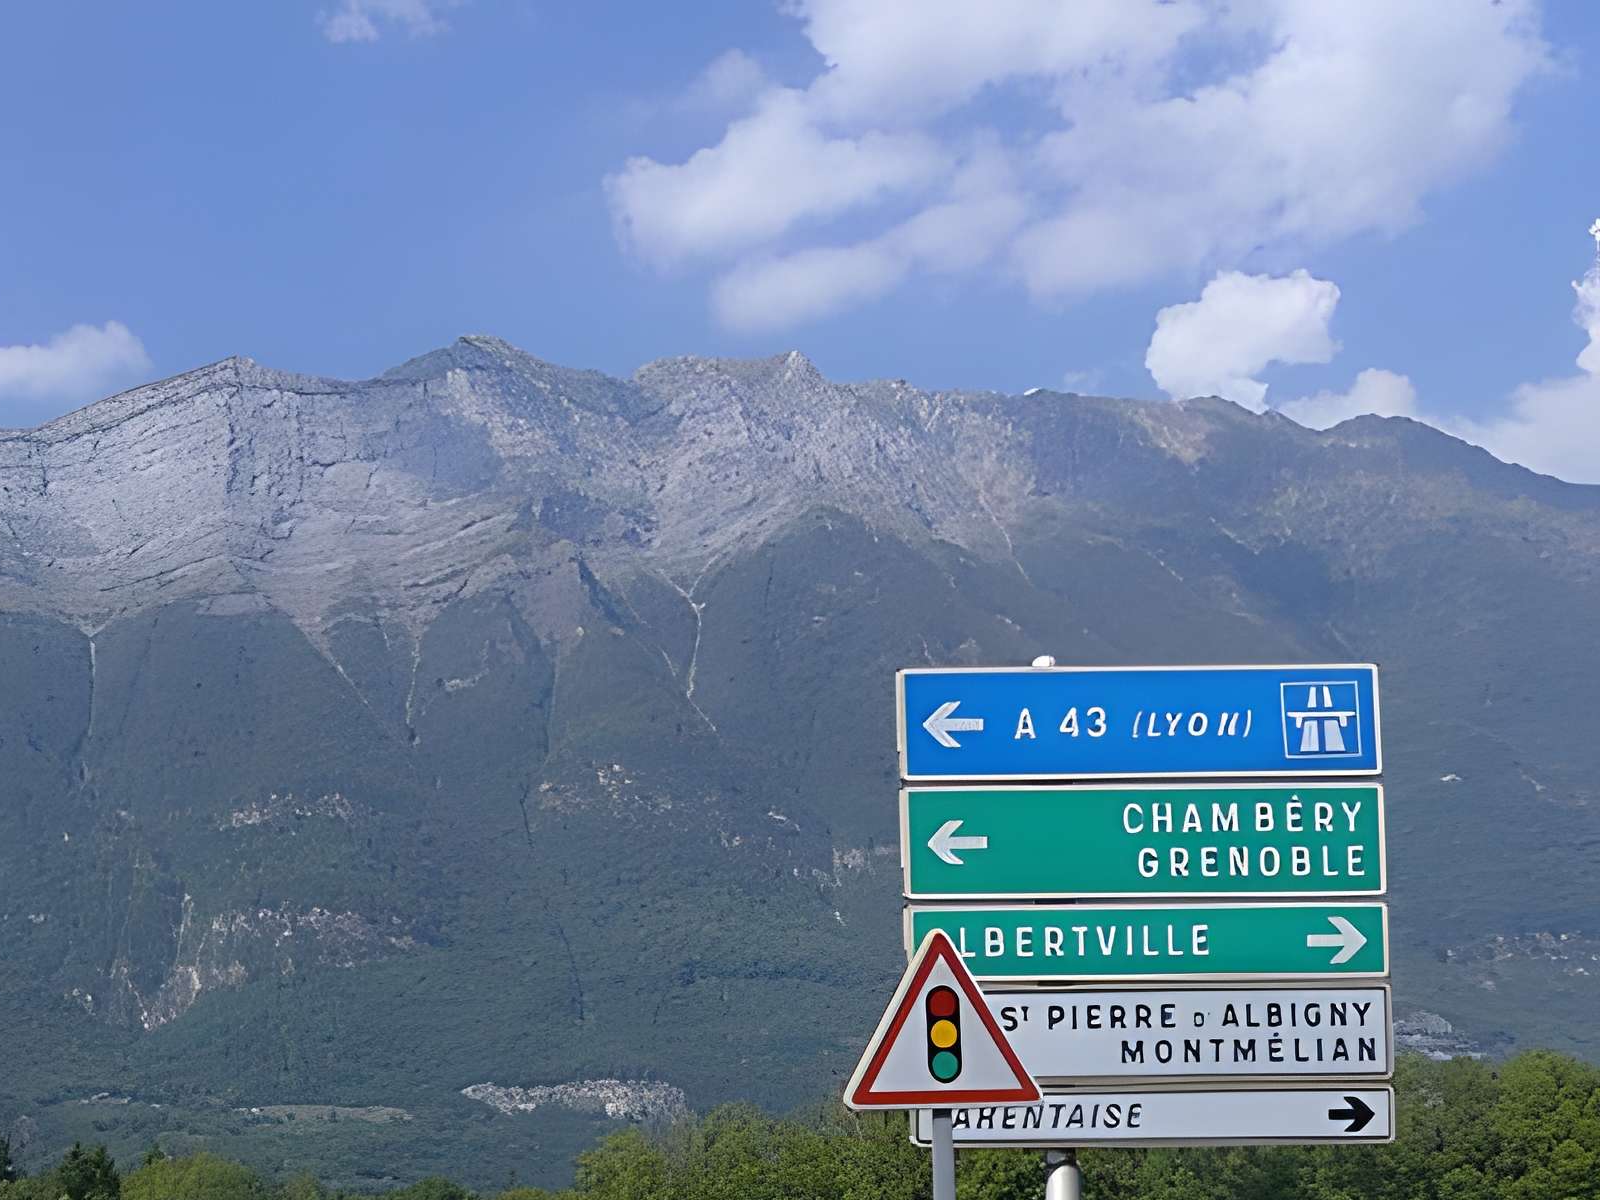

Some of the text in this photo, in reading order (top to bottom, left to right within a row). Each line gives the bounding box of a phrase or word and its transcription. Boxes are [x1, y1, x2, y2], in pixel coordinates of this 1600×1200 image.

[1014, 707, 1037, 739] A
[1059, 706, 1107, 737] 43
[1122, 794, 1362, 833] CHAMBÉRY
[1137, 845, 1366, 878] GRENOBLE
[959, 924, 1210, 958] LBERTVILLE
[1047, 1003, 1176, 1030] PIERRE
[1120, 1032, 1377, 1064] MONTMÉLIAN
[952, 1103, 1143, 1129] ARENTAISE
